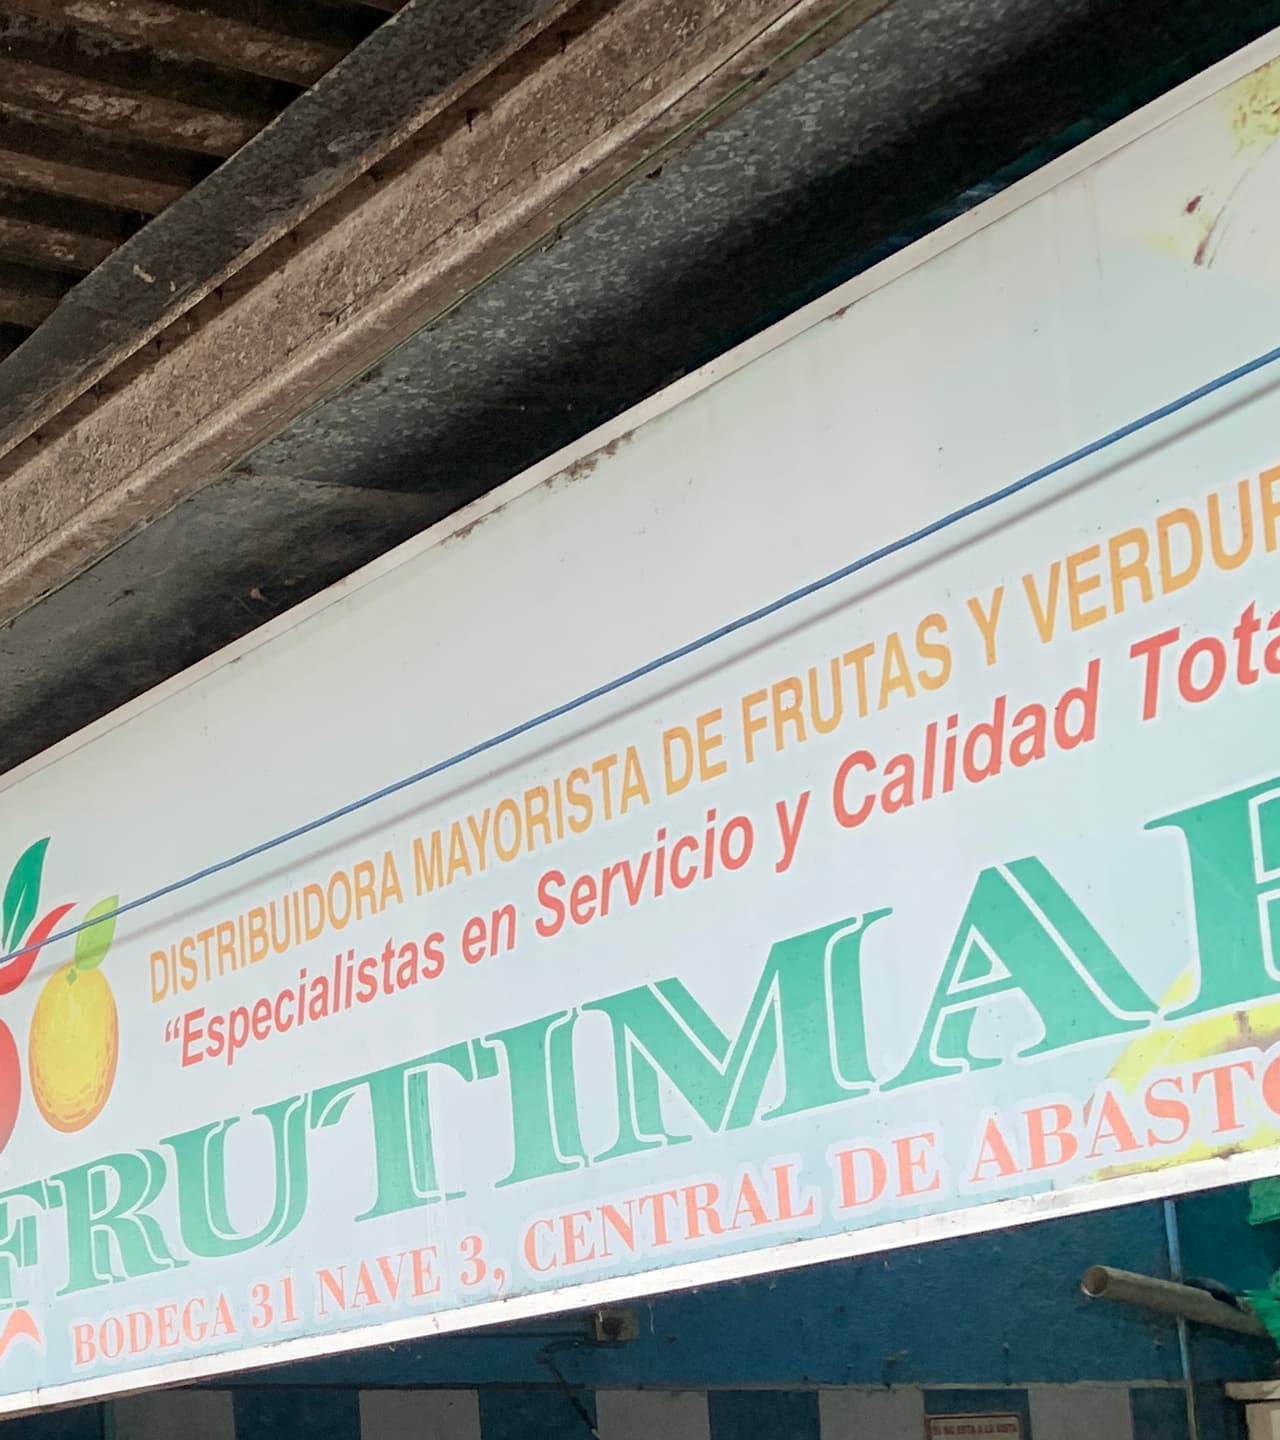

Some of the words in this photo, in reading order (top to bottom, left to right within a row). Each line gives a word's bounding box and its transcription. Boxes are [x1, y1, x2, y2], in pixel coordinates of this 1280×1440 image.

[149, 851, 403, 1003] DISTRIBUIDORA
[413, 746, 650, 896] MAYORISTA
[662, 708, 727, 796] DE
[741, 612, 952, 764] FRUTAS
[966, 585, 1005, 667] Y
[460, 904, 517, 966] en
[534, 814, 755, 938] Servicio
[774, 790, 812, 874] y
[831, 656, 1102, 831] Calidad
[72, 1292, 238, 1366] BODEGA
[250, 1275, 300, 1329] 31
[314, 1245, 441, 1316] NAVE
[459, 1234, 506, 1291] 3,
[522, 1162, 816, 1274] CENTRAL
[833, 1131, 942, 1210] DE
